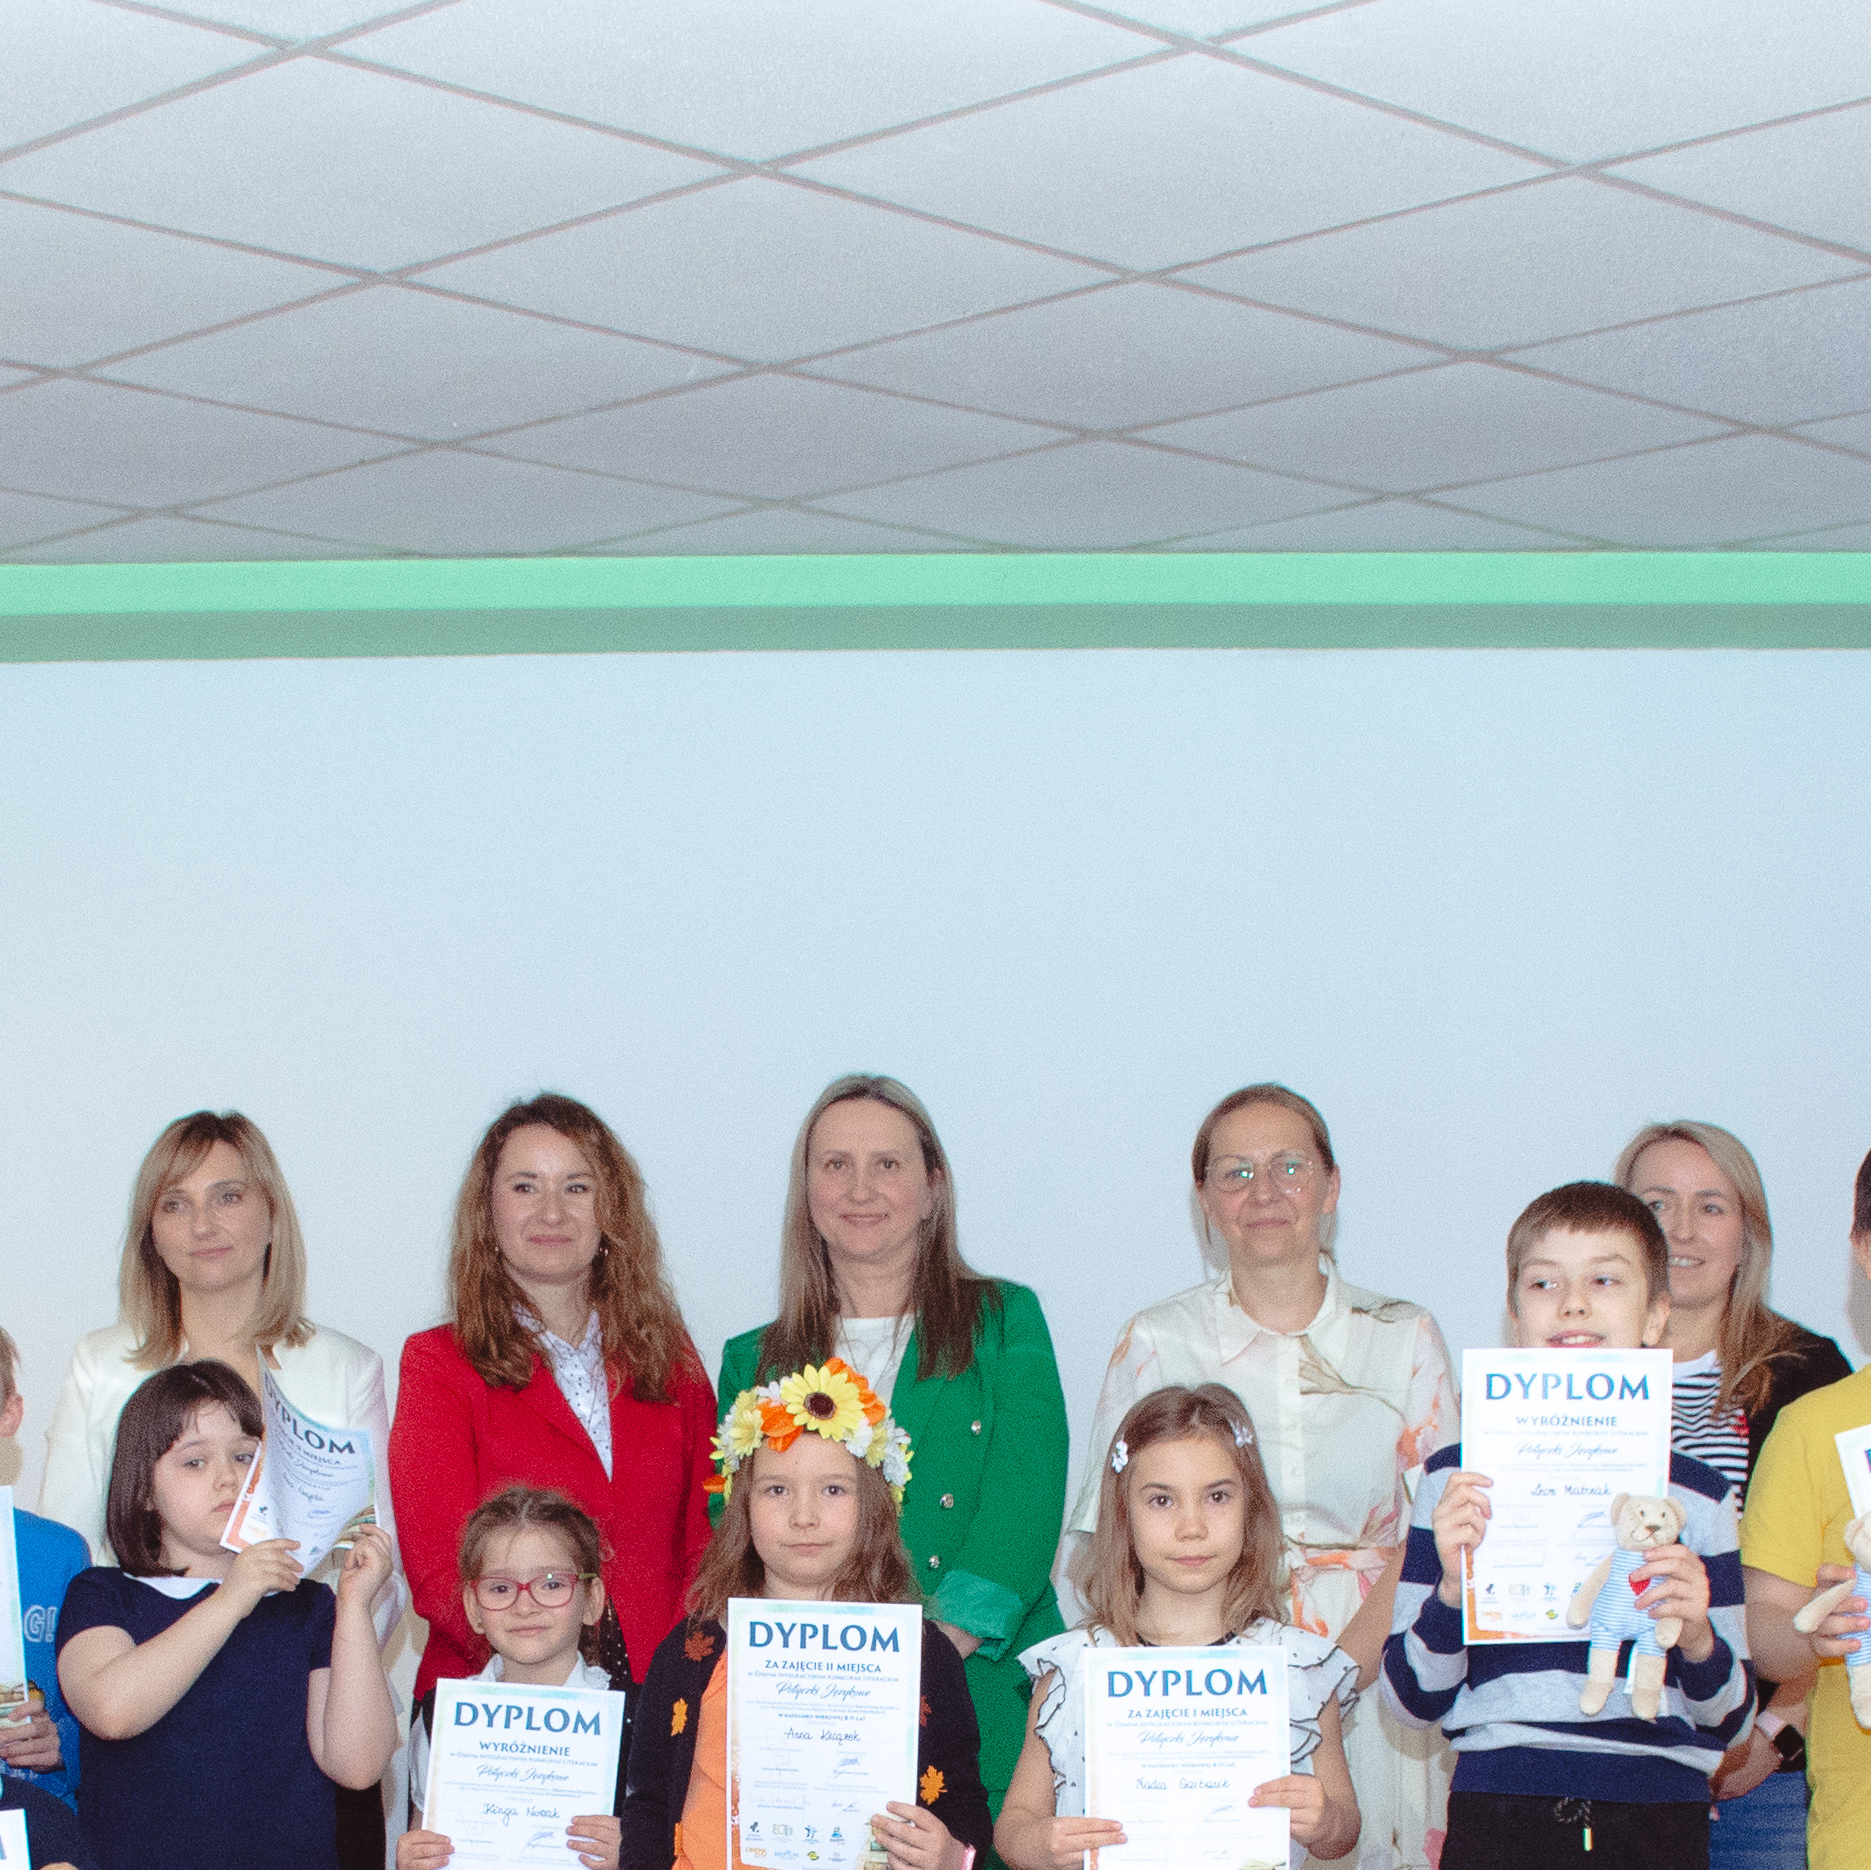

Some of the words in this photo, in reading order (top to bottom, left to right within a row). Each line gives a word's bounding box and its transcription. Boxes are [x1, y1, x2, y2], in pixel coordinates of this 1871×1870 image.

[1485, 1372, 1650, 1401] DYPLOM
[1516, 1413, 1618, 1427] WYRÓŻNIENIE
[749, 1621, 900, 1653] DYPLOM
[765, 1660, 780, 1669] ZA
[781, 1660, 824, 1673] ZAJĘCIE
[826, 1662, 833, 1671] II
[836, 1663, 881, 1674] MIEJSCA
[1107, 1669, 1268, 1698] DYPLOM
[454, 1701, 601, 1736] DYPLOM
[1128, 1709, 1143, 1719] ZA
[1146, 1708, 1190, 1721] ZAJĘCIE
[1193, 1709, 1197, 1717] I
[1200, 1708, 1248, 1719] MIEJSCA
[479, 1740, 570, 1756] WYRÓŻNIENIE
